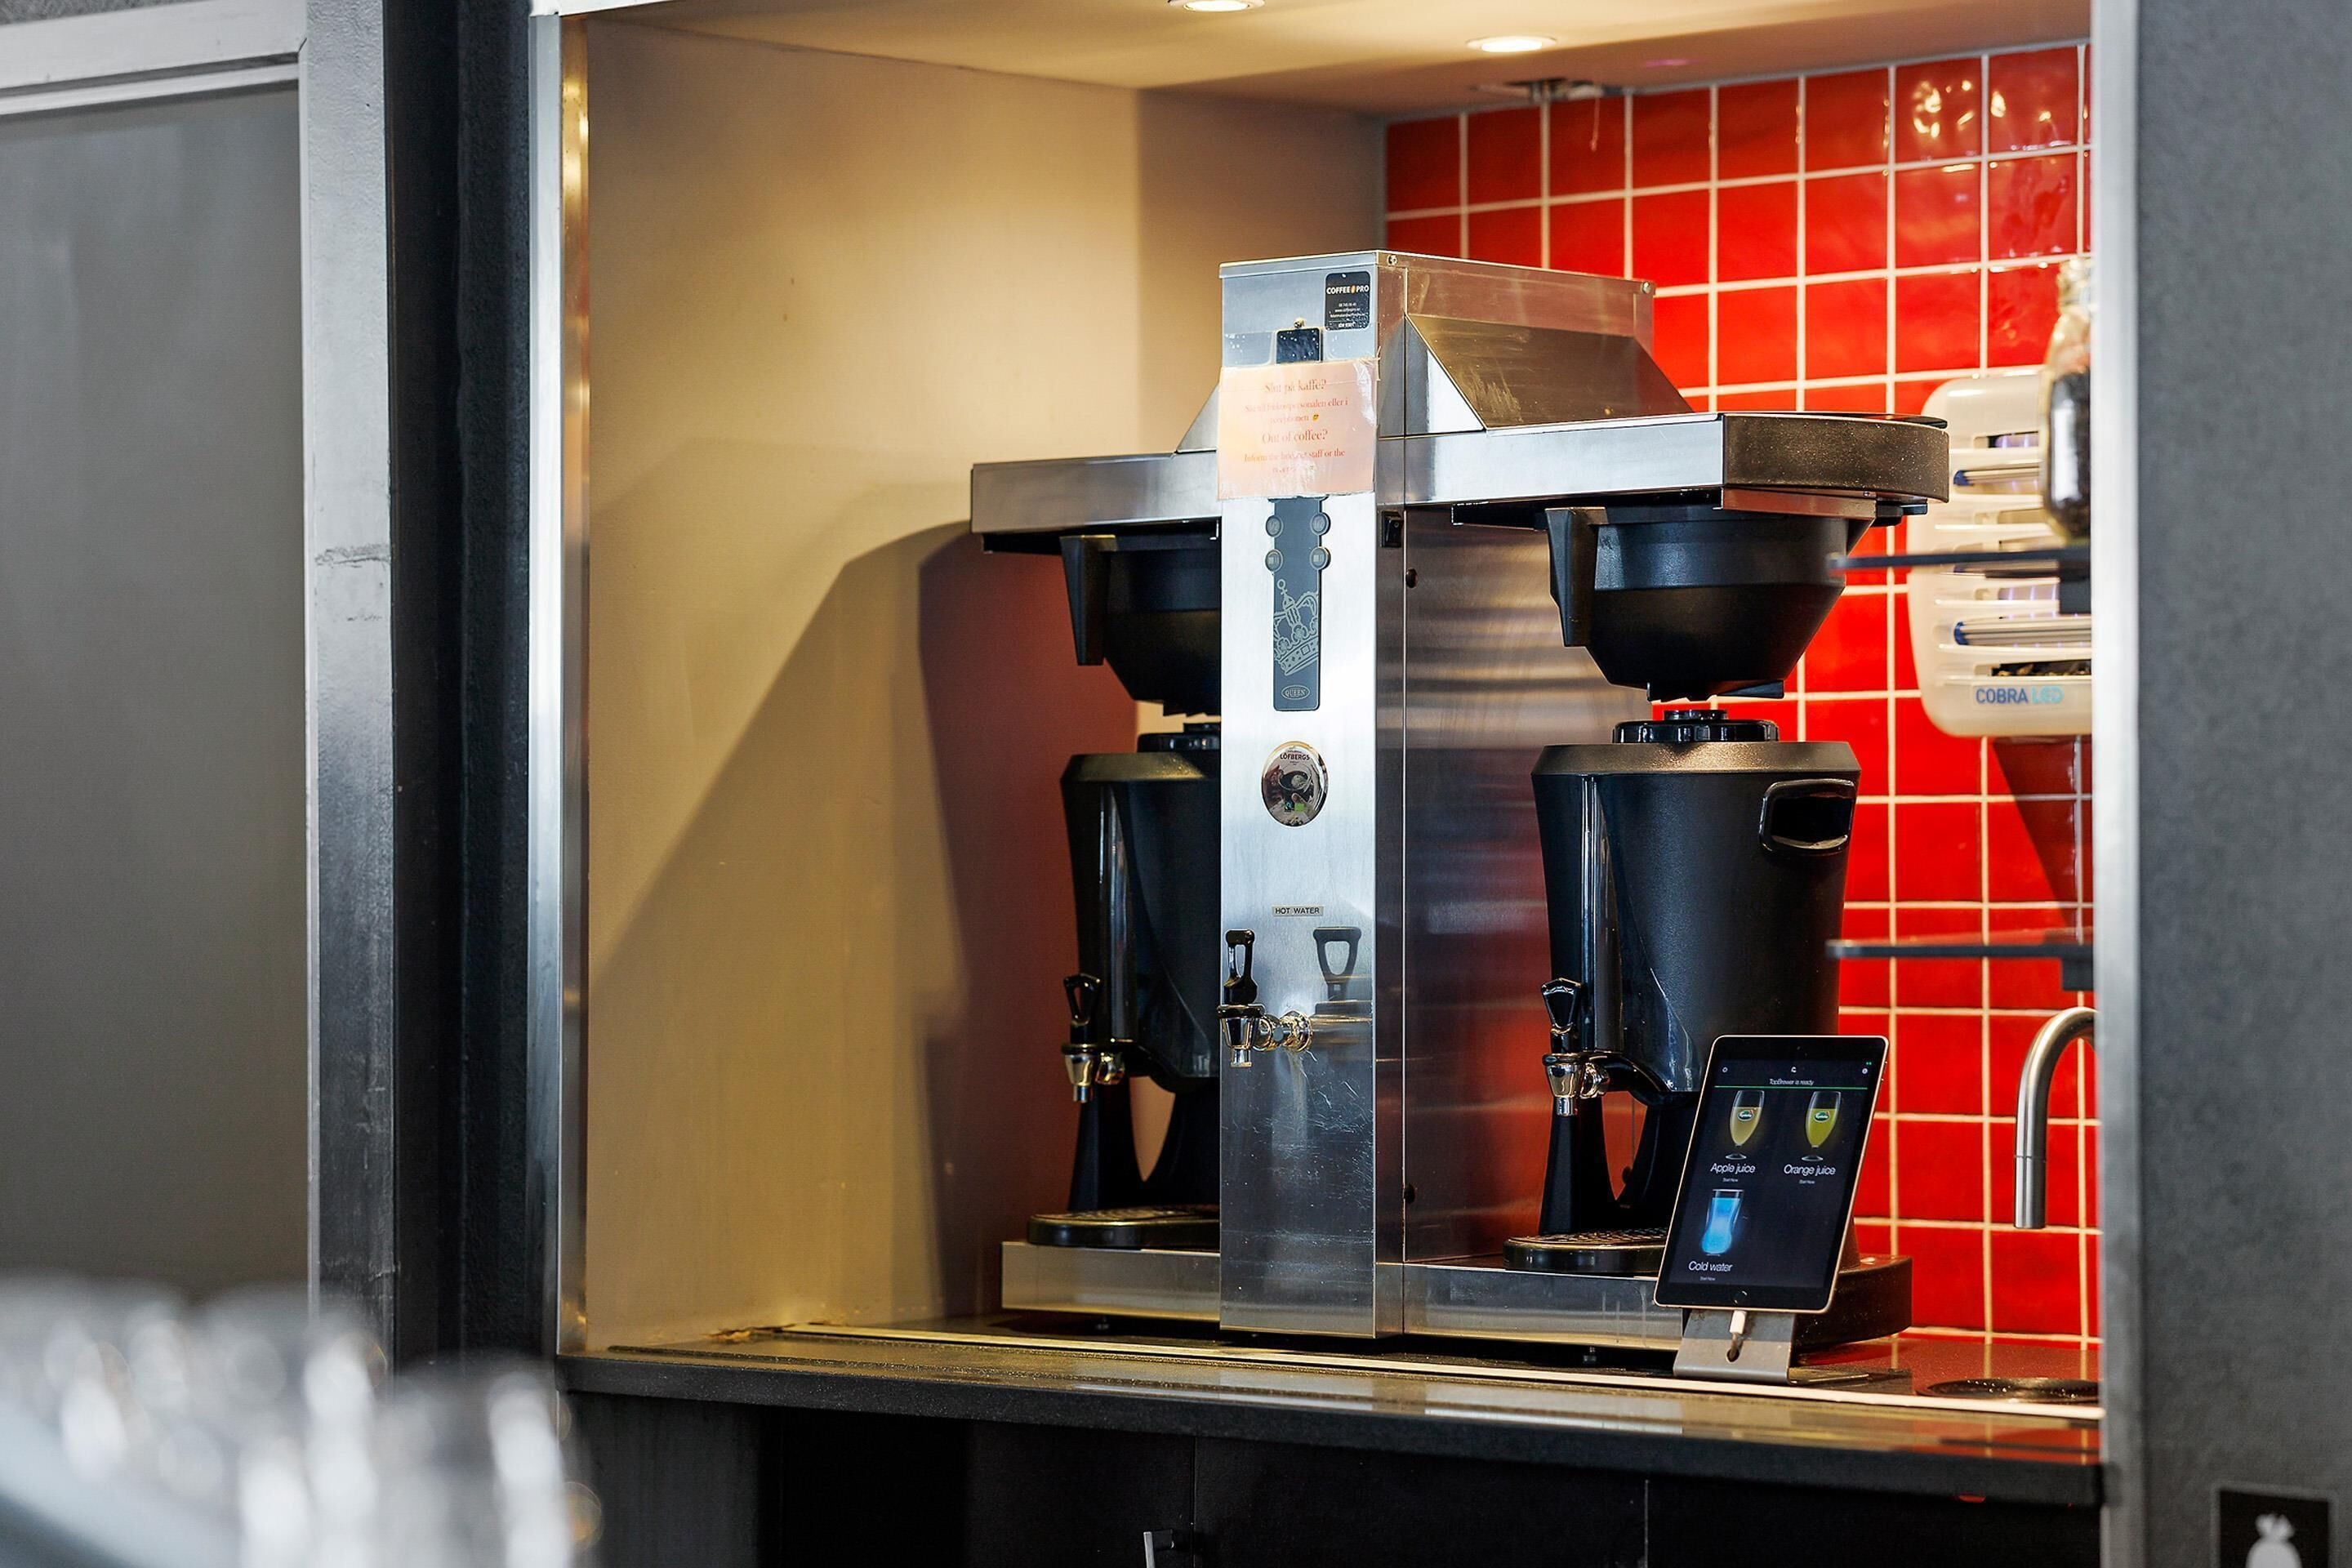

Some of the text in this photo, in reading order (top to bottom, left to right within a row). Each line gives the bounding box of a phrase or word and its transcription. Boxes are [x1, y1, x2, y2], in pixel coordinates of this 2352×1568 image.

[1326, 285, 1370, 295] COFFEE PRO
[1298, 379, 1327, 391] kaffe?
[1262, 429, 1329, 444] Out of coffee?
[1334, 448, 1346, 457] the
[1976, 685, 2065, 704] COBRA LED
[1710, 1163, 1757, 1174] Apple juice
[1784, 1164, 1837, 1177] Orange juice
[1688, 1260, 1733, 1272] Cold water
